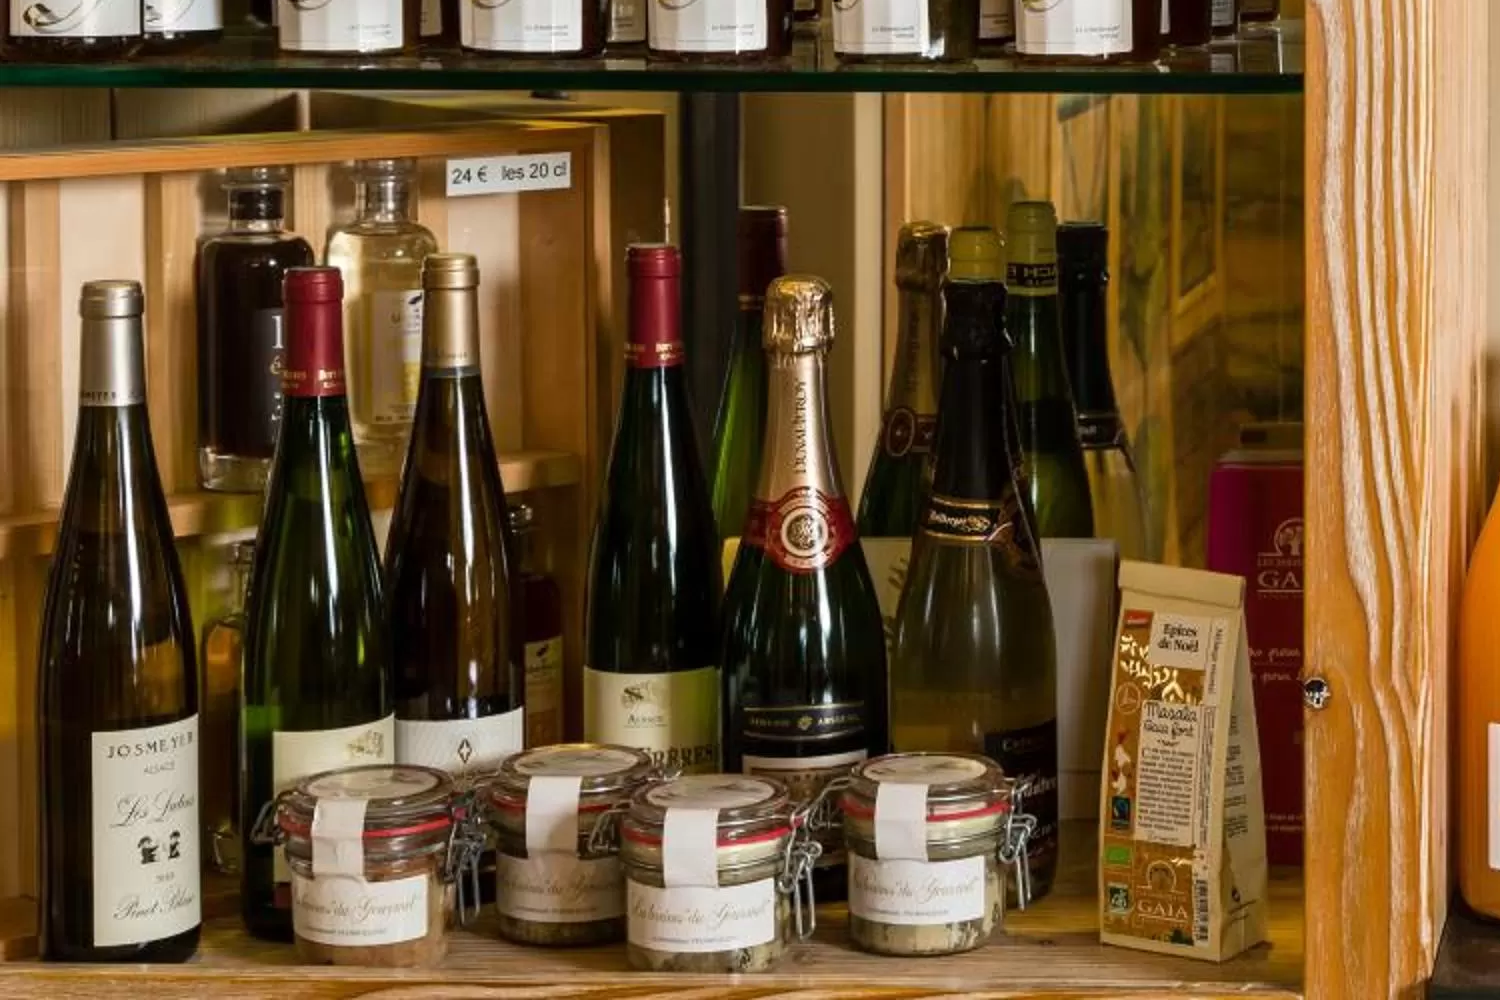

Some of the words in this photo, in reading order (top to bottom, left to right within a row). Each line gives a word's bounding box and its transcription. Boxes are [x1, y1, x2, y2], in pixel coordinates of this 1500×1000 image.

[452, 168, 472, 184] 24
[477, 165, 489, 183] €
[501, 166, 524, 181] les
[529, 162, 549, 179] 20
[553, 161, 567, 177] cl
[1257, 570, 1301, 589] GA
[106, 731, 194, 760] JOSMEYER
